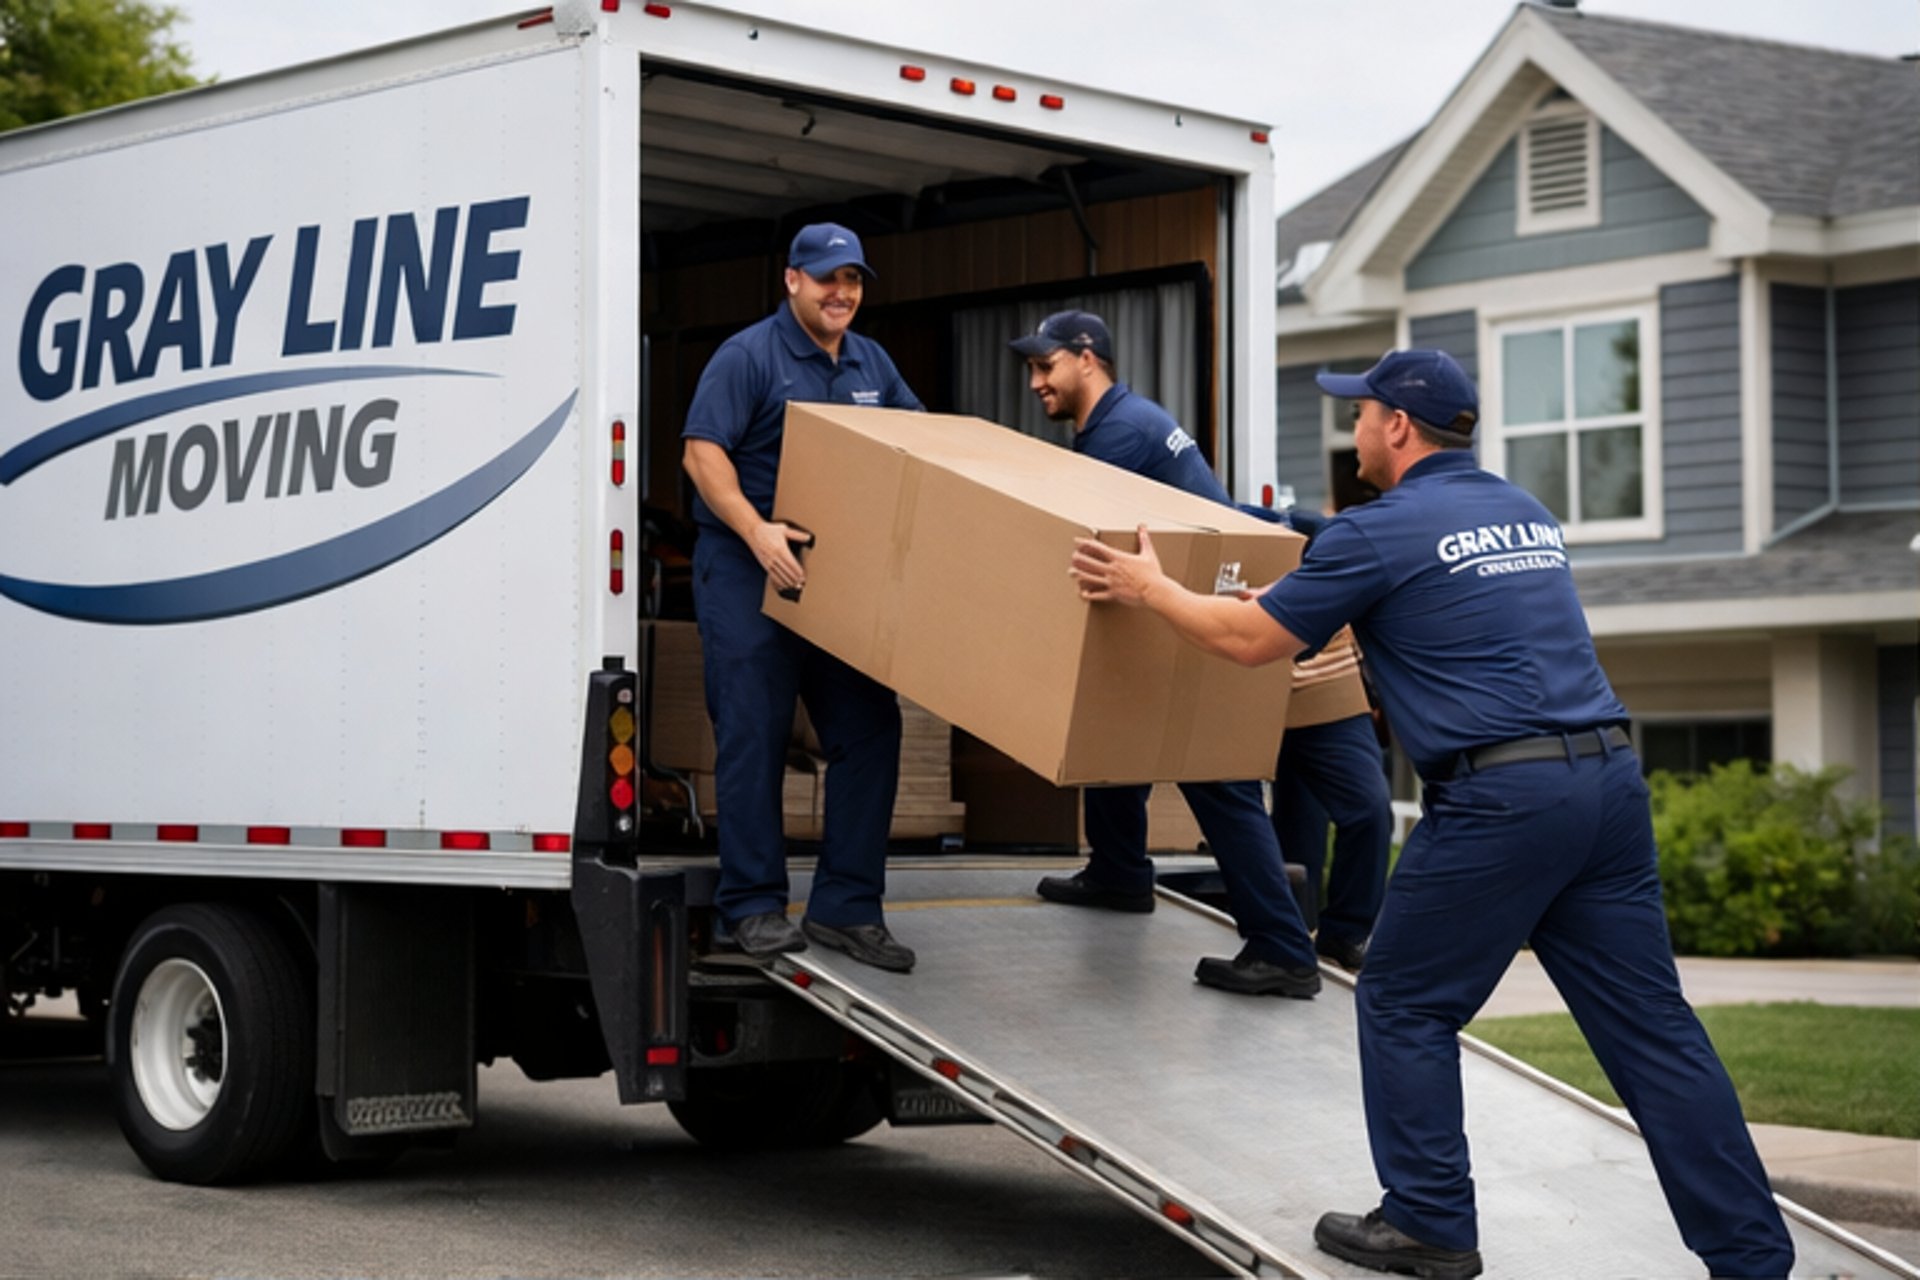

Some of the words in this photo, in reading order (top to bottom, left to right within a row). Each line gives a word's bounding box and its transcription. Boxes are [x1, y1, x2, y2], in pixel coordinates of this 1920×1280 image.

[18, 235, 274, 401] GRAY
[281, 196, 530, 357] LINE
[105, 398, 399, 520] MOVING
[1437, 525, 1513, 563] GRAY
